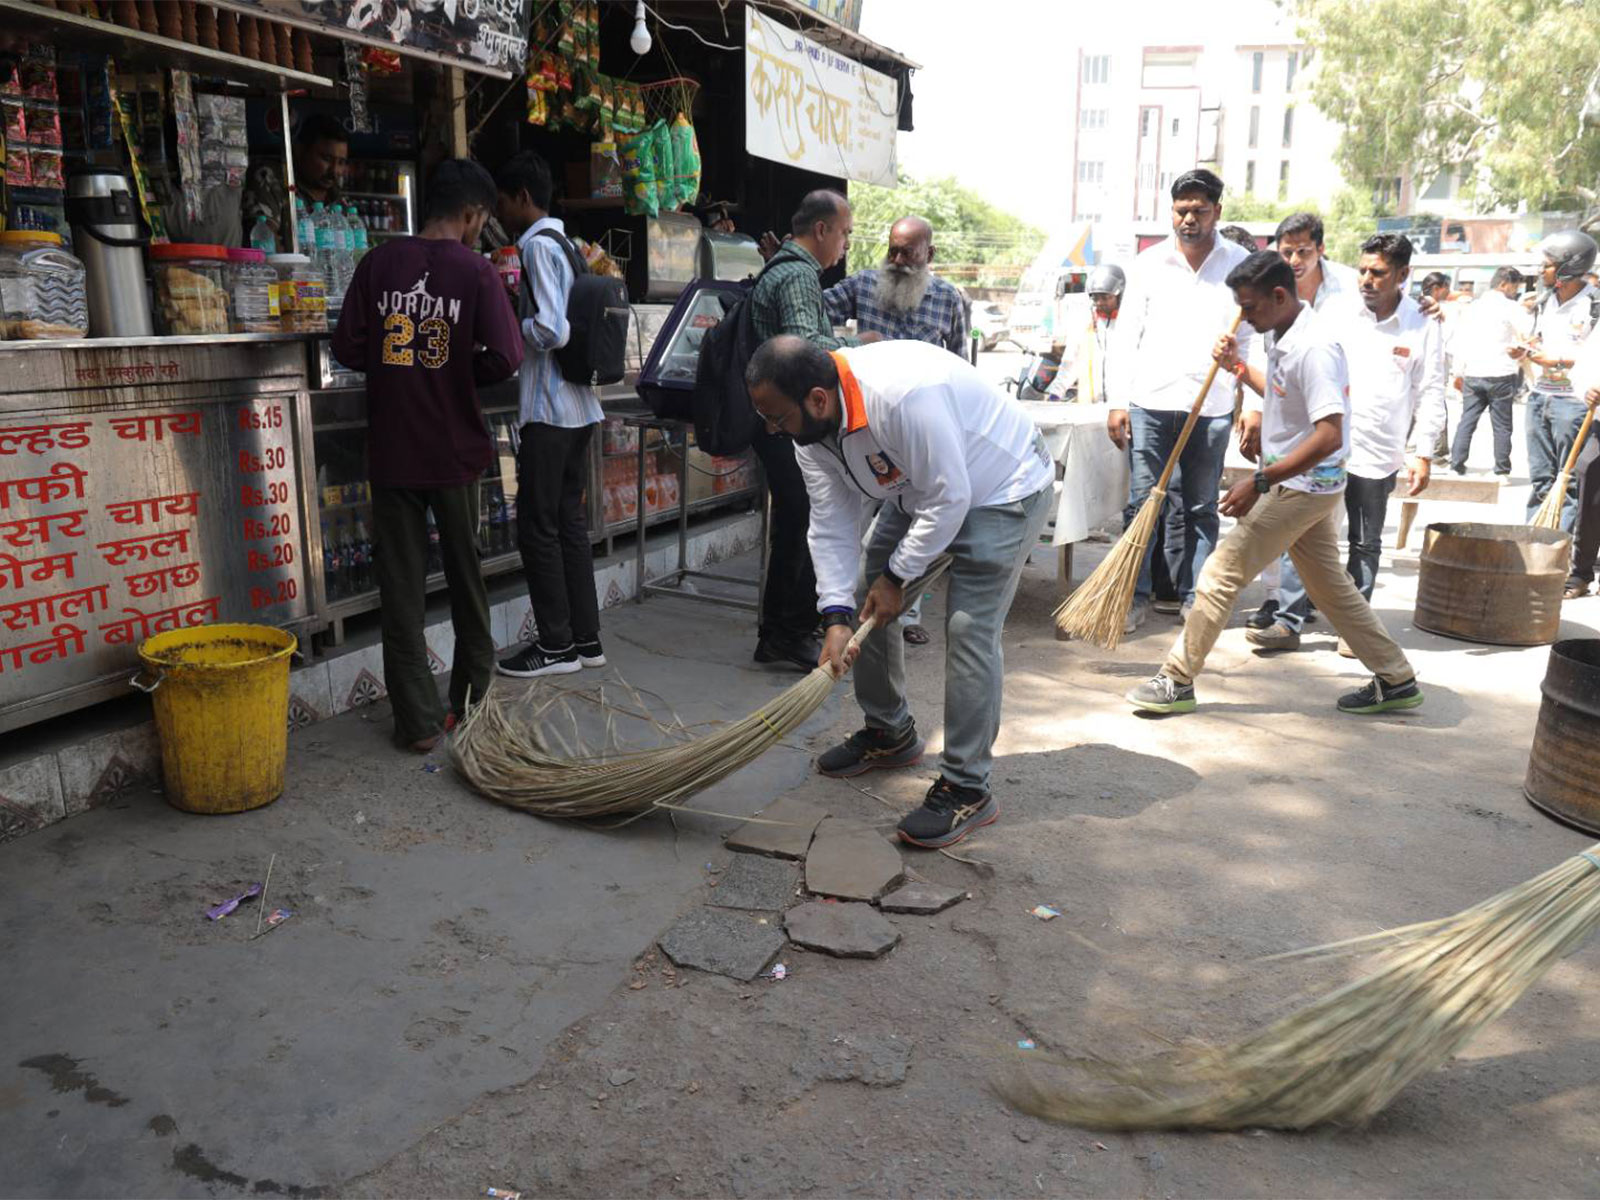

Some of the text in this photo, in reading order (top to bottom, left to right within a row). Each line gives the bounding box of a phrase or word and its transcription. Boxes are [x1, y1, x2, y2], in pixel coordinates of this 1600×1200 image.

[805, 83, 853, 151] चाय
[377, 290, 461, 324] JORDAN
[382, 312, 450, 368] 23
[0, 405, 282, 455] ल्हड चाय Rs.15
[239, 446, 285, 473] Rs.30
[0, 509, 88, 547] सर
[105, 491, 201, 525] चाय
[241, 481, 288, 508] Rs.30
[96, 529, 190, 566] रूल
[243, 513, 290, 540] Rs.20
[0, 543, 293, 631] साला छाछ Rs.20
[98, 596, 221, 644] बोतल
[250, 578, 296, 611] Rs.20
